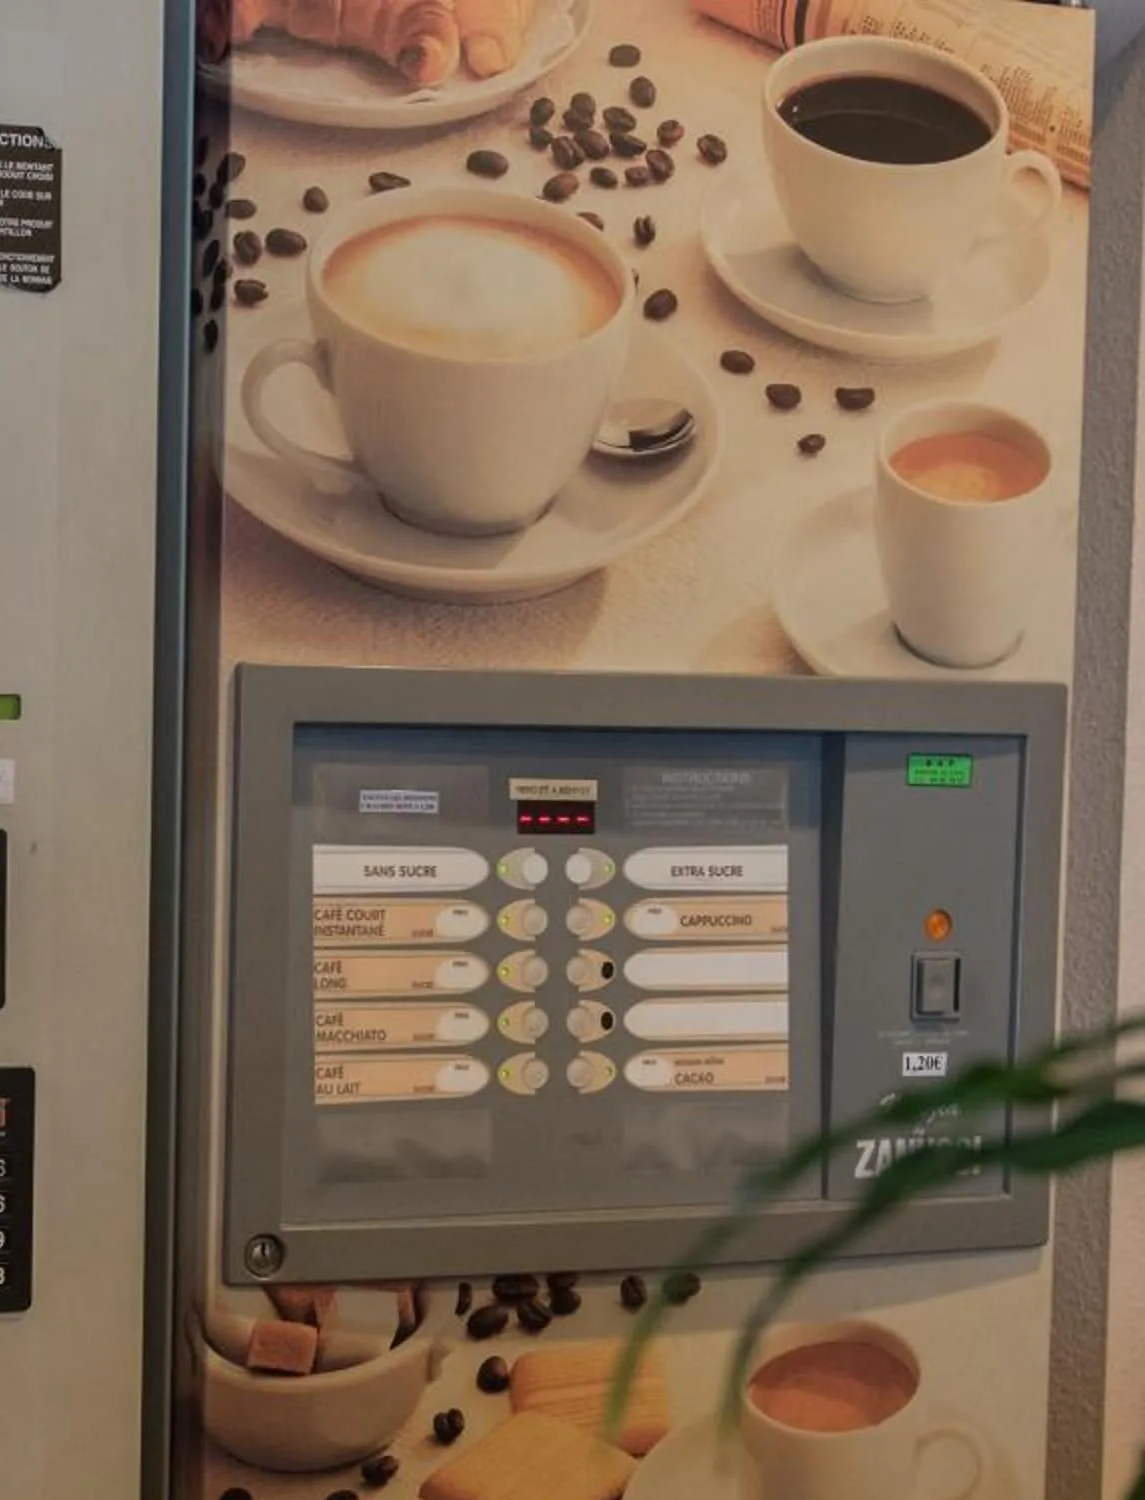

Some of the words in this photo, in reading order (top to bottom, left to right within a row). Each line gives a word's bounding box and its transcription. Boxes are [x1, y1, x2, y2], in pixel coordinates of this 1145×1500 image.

[363, 865, 397, 878] SANS
[399, 865, 438, 879] SUCRE
[670, 865, 706, 878] EXTRA
[708, 865, 743, 878] SUCRE
[346, 909, 386, 922] COURT
[680, 915, 753, 928] CAPPUCCINO
[315, 960, 343, 975] CAFÉ
[316, 1012, 344, 1027] CAFÉ
[316, 1029, 387, 1042] MACCHIATO
[316, 1065, 344, 1080] CAFÉ
[674, 1072, 715, 1085] CACAO
[316, 1083, 334, 1095] AU
[336, 1082, 361, 1095] LAIT
